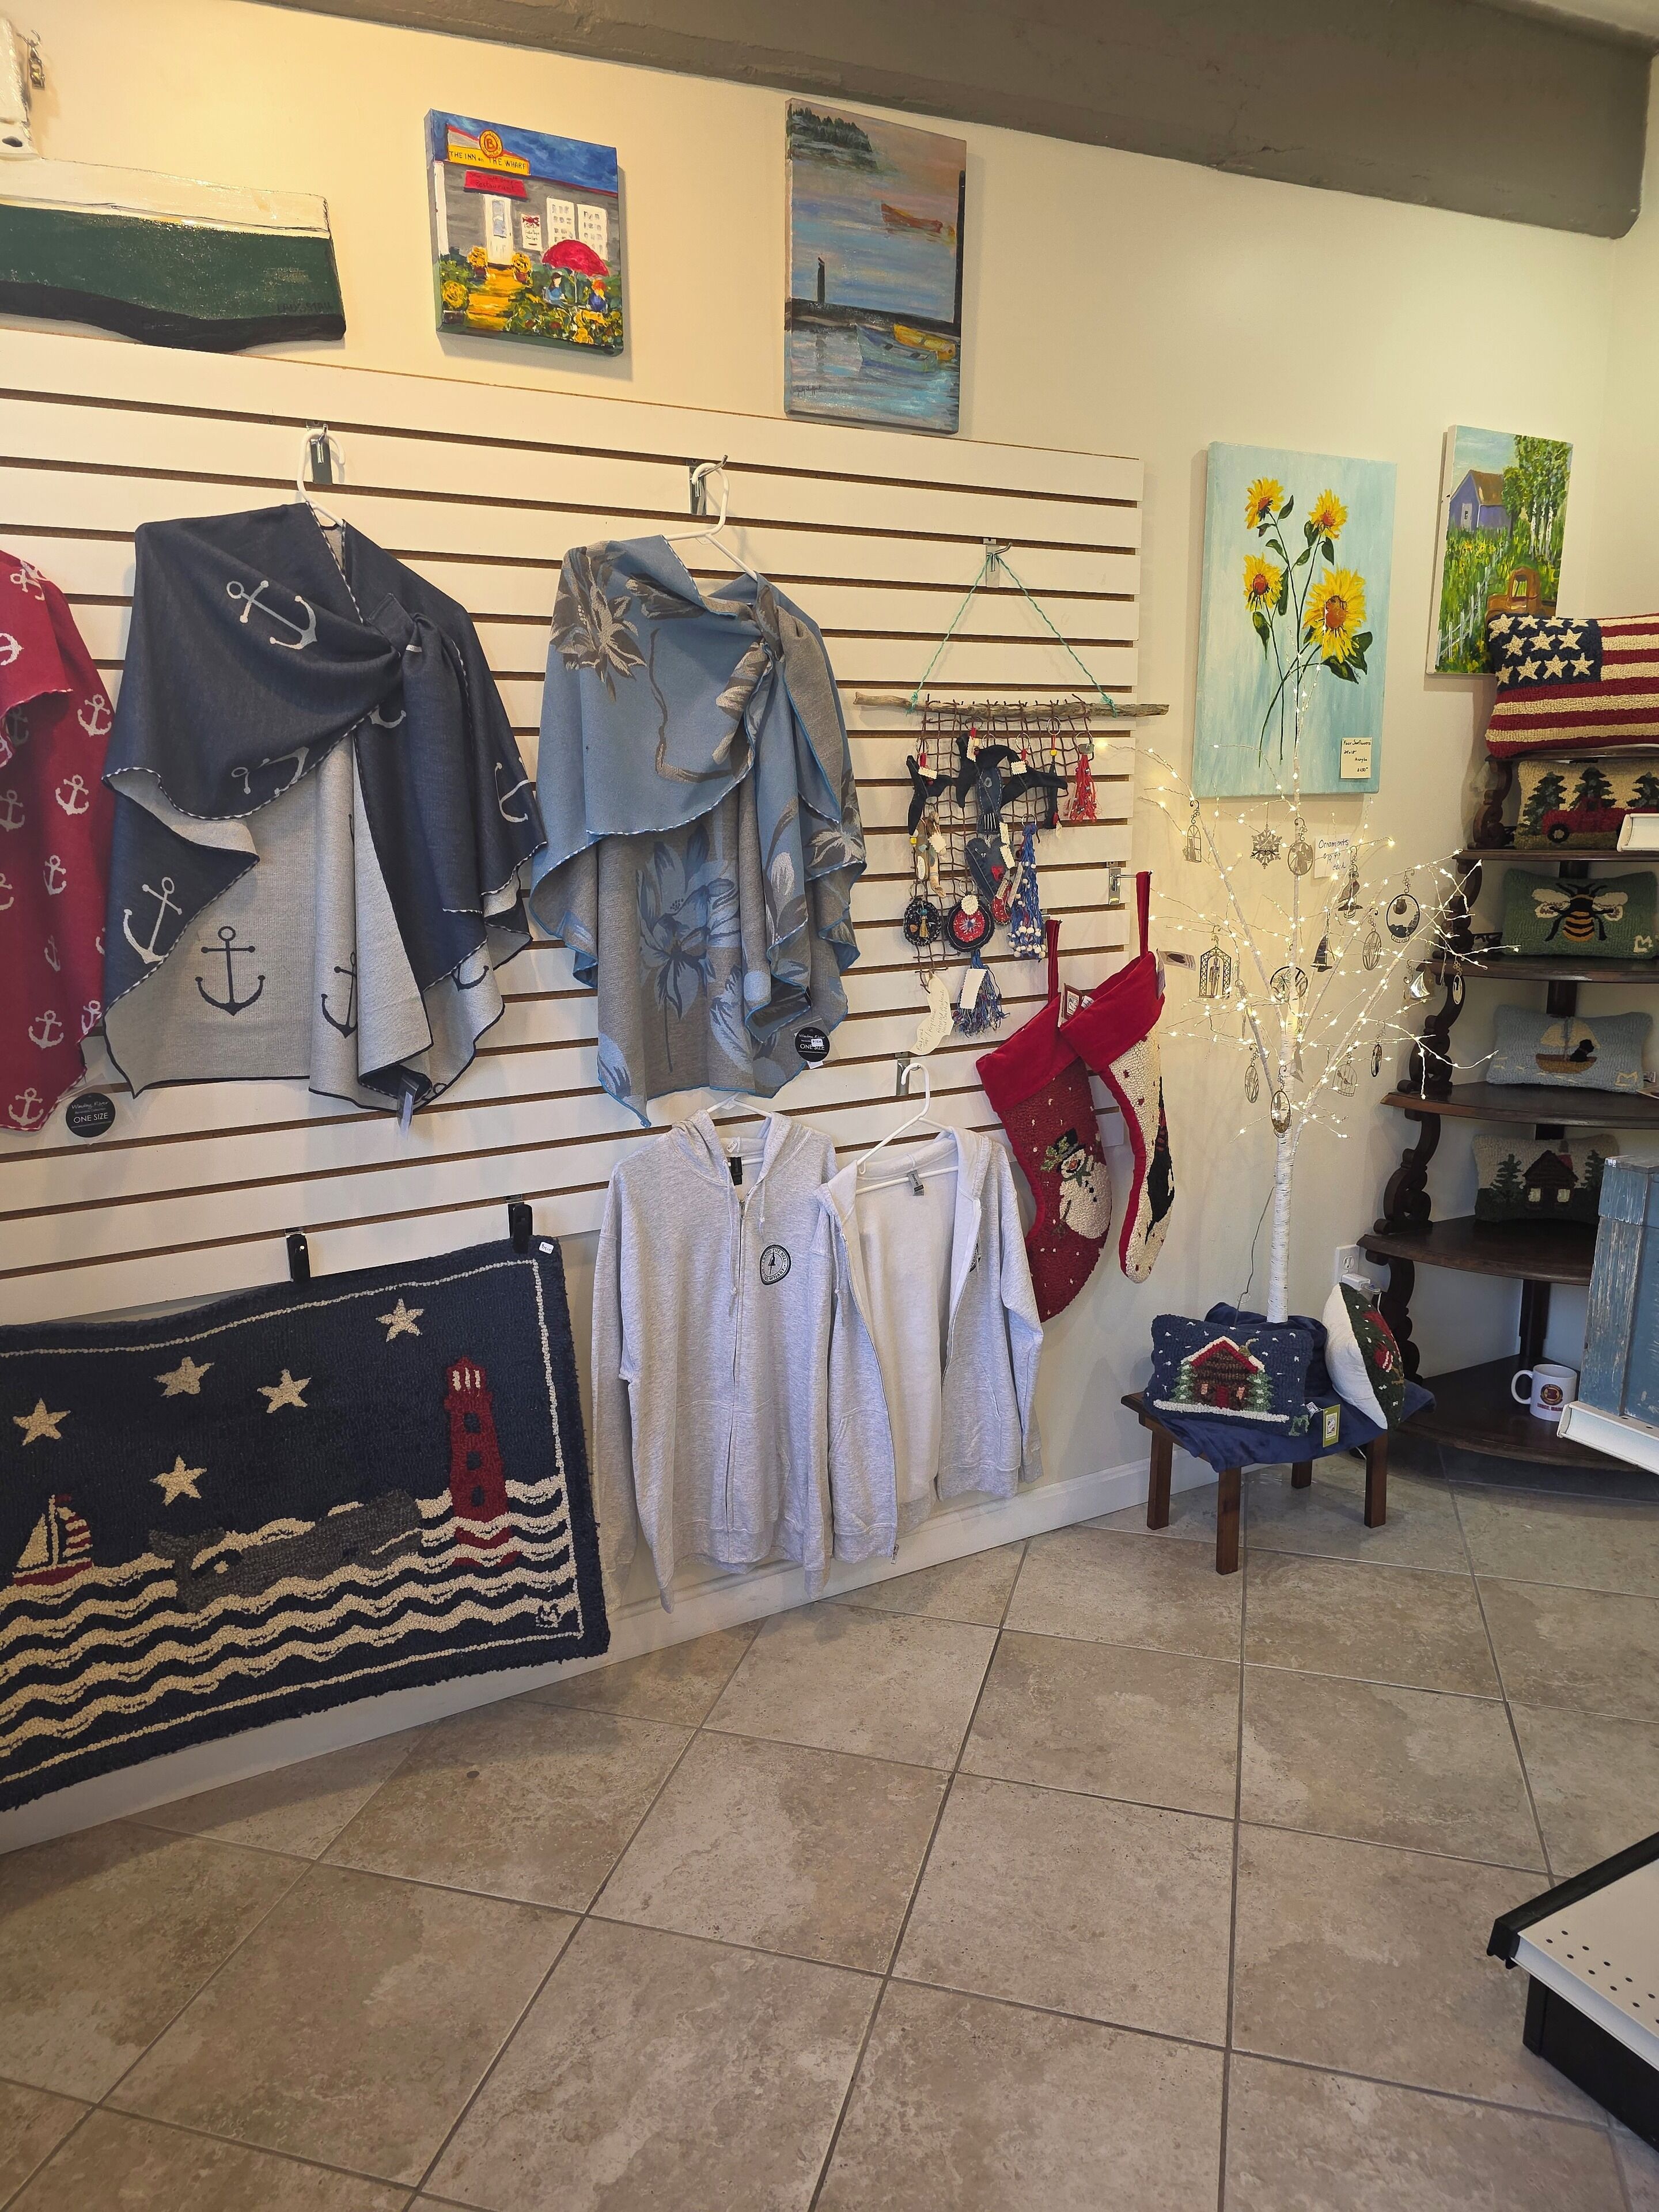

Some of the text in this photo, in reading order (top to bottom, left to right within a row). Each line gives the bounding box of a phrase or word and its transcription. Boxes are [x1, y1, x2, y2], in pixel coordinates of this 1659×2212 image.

[449, 150, 463, 158] THE
[464, 153, 477, 161] INN
[488, 157, 503, 166] THE
[504, 160, 526, 170] WHARF
[1318, 839, 1349, 849] Ornaments
[74, 1112, 109, 1123] ONE SIZE
